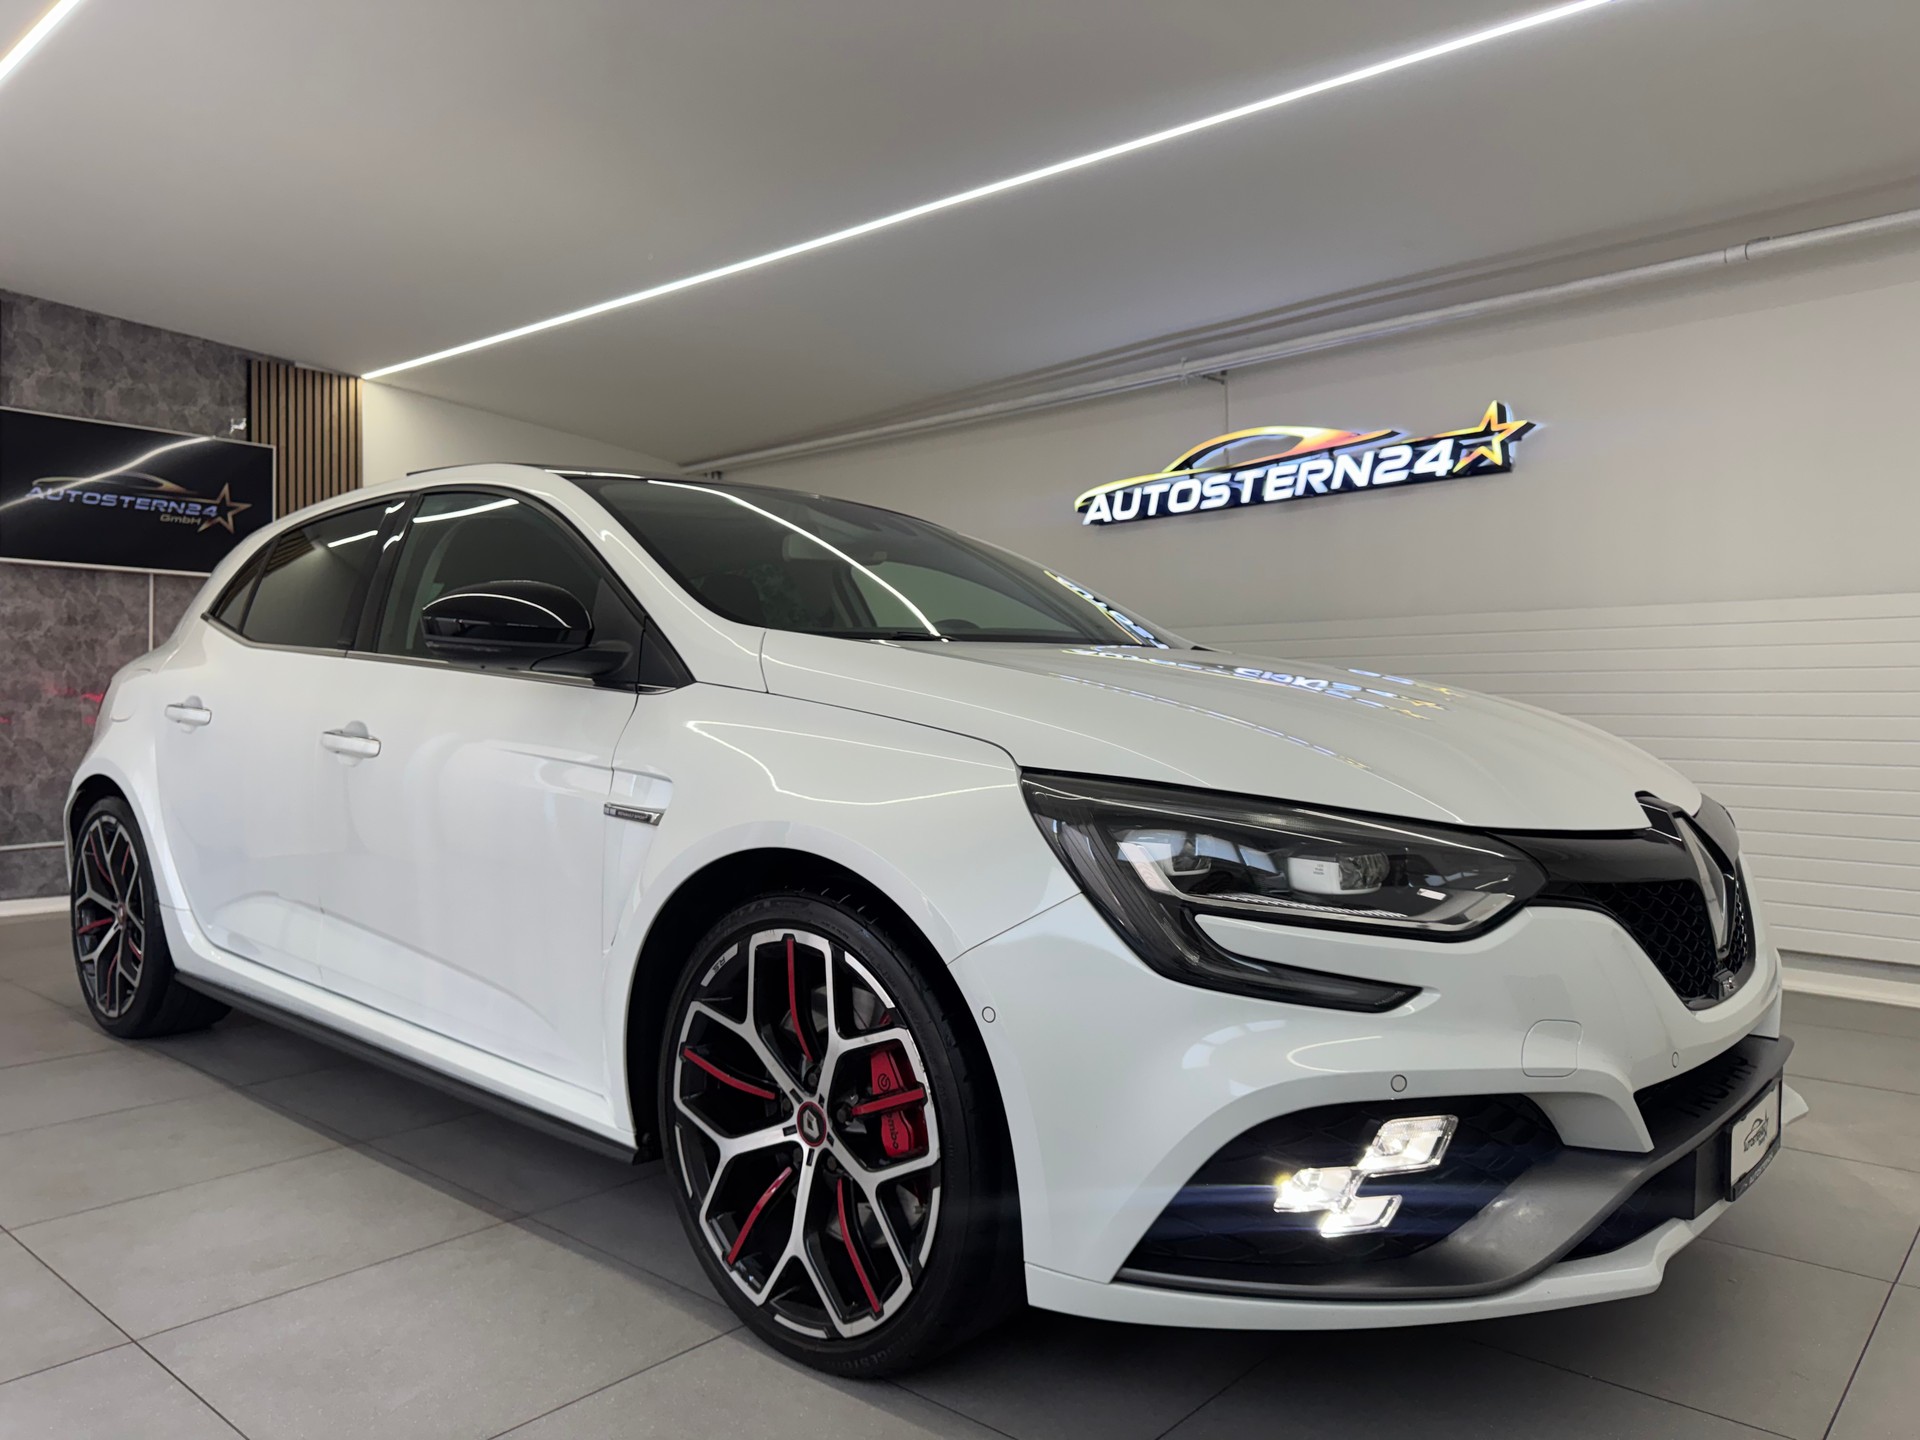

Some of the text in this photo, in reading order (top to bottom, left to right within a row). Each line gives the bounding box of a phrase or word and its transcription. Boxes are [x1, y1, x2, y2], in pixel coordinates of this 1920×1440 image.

[1082, 438, 1455, 526] AUTOSTERN24
[25, 486, 218, 518] AUTOSTERN24
[159, 513, 203, 526] GmbH
